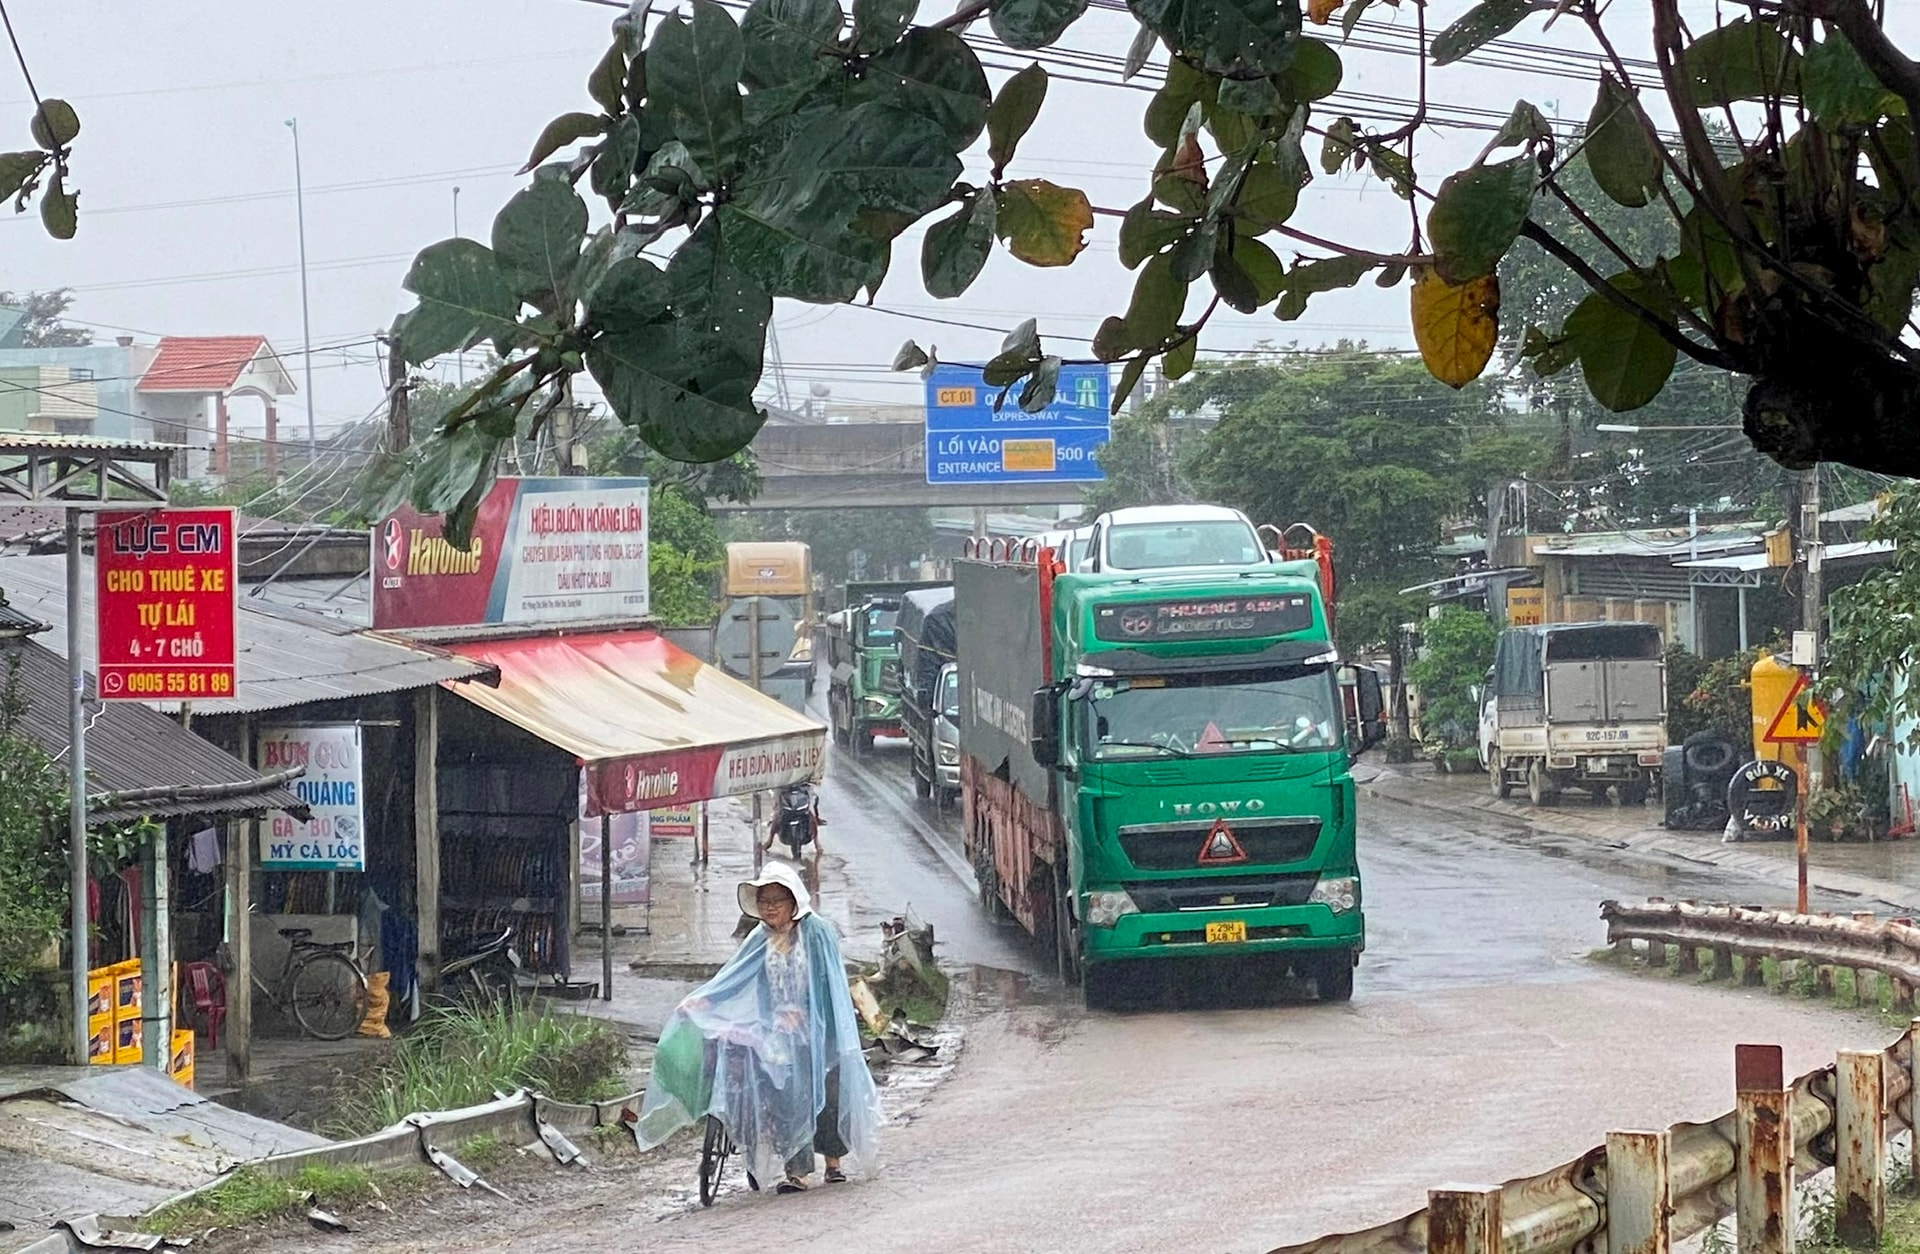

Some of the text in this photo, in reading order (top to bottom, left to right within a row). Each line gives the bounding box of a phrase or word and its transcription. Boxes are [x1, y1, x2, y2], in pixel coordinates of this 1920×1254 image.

[940, 391, 973, 404] CT.01
[992, 411, 1060, 422] EXPRESSWAY
[938, 434, 963, 455] LỐI
[968, 436, 1000, 454] VÀO
[1056, 447, 1083, 461] 500
[938, 462, 1001, 474] ENTRANCE
[176, 523, 221, 553] CM
[107, 564, 224, 592] CHO THUÊ XE
[137, 599, 195, 630] TỰ LÁI
[129, 639, 141, 657] 4
[155, 639, 166, 657] 7
[170, 632, 203, 657] CHỖ
[127, 673, 229, 692] 0905 55 81 89
[264, 734, 311, 768] BÚN
[1774, 765, 1789, 781] XE
[1173, 799, 1265, 815] HOWO
[300, 841, 323, 859] CÁ
